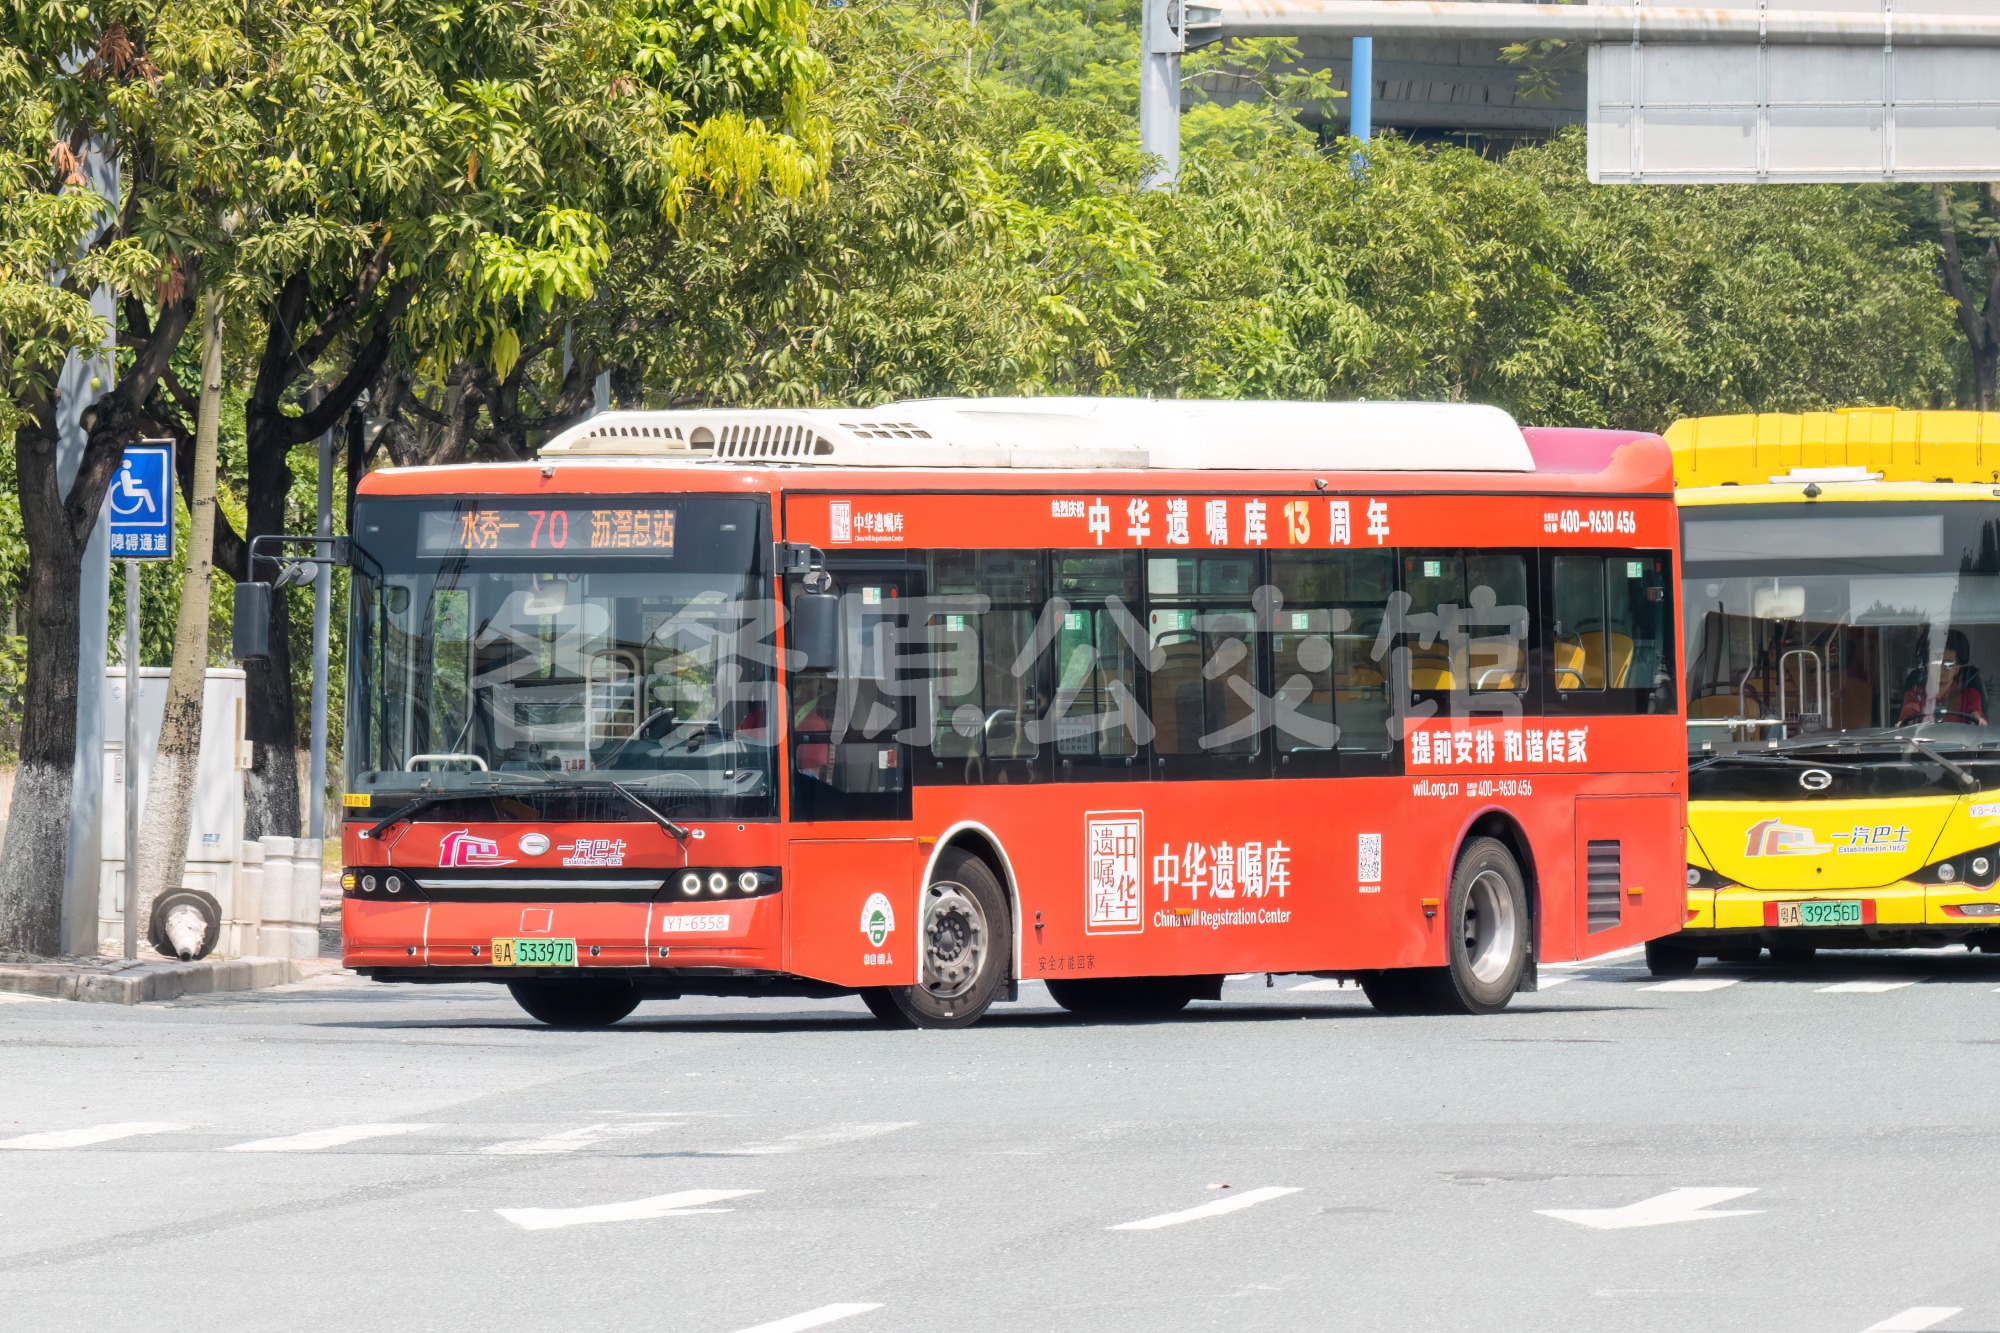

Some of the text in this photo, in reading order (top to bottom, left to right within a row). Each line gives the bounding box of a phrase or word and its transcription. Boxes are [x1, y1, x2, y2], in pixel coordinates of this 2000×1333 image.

[1051, 500, 1085, 518] 热烈庆祝
[527, 510, 569, 549] 70
[853, 512, 904, 533] 中华遗嘱库
[1616, 511, 1636, 533] 456
[111, 533, 167, 551] 障碍通道
[1411, 729, 1588, 765] 提前安排 和谐传家
[1412, 779, 1459, 799] will.org.cn
[1517, 780, 1532, 796] 456
[1970, 805, 2000, 816] Y3-4
[1831, 825, 1912, 845] 一汽巴士
[557, 839, 627, 858] 一汽巴士
[1093, 826, 1115, 919] 遗嘱库
[1115, 826, 1137, 918] 中华
[1153, 840, 1291, 901] 中华遗嘱库
[667, 916, 725, 931] Y1-6558
[1153, 910, 1181, 928] China
[1200, 908, 1256, 930] Registration
[1257, 908, 1291, 924] Center
[1805, 904, 1860, 923] 39256D
[519, 942, 573, 962] 53397D
[1039, 955, 1095, 972] 安全才能回家
